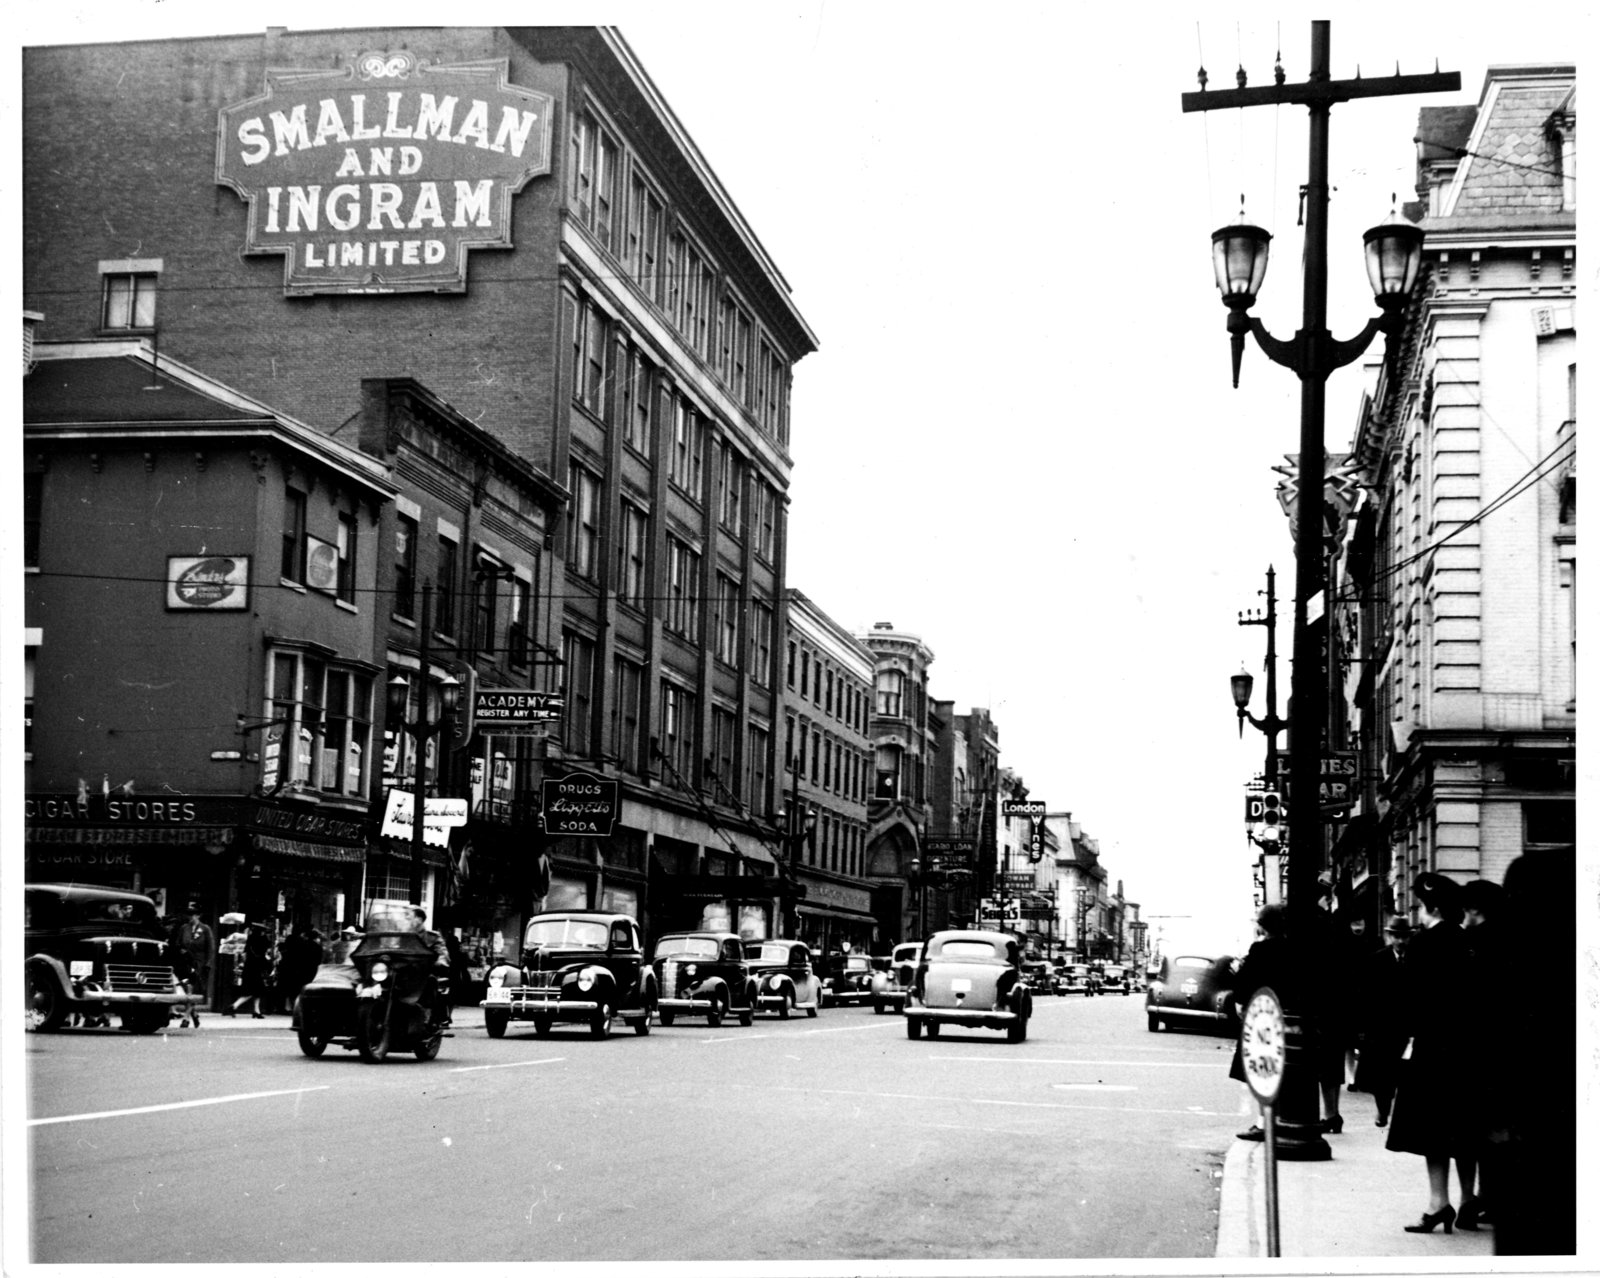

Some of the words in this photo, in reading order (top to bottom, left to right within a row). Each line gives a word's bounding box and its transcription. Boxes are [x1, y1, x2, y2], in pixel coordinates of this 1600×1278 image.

[238, 91, 538, 166] SMALLMAN
[335, 145, 423, 177] AND
[264, 179, 494, 233] INGRAM
[304, 239, 446, 267] LIMITED
[478, 695, 547, 708] ACADEMY
[476, 709, 510, 718] REGISTER
[513, 710, 529, 718] ANY
[533, 710, 549, 719] TIME
[1277, 758, 1356, 775] LIES
[560, 783, 602, 795] DRUGS
[26, 801, 88, 819] CIGAR
[108, 801, 195, 821] STORES
[1004, 802, 1045, 813] London
[559, 821, 597, 832] SODA
[1031, 815, 1043, 859] Wines
